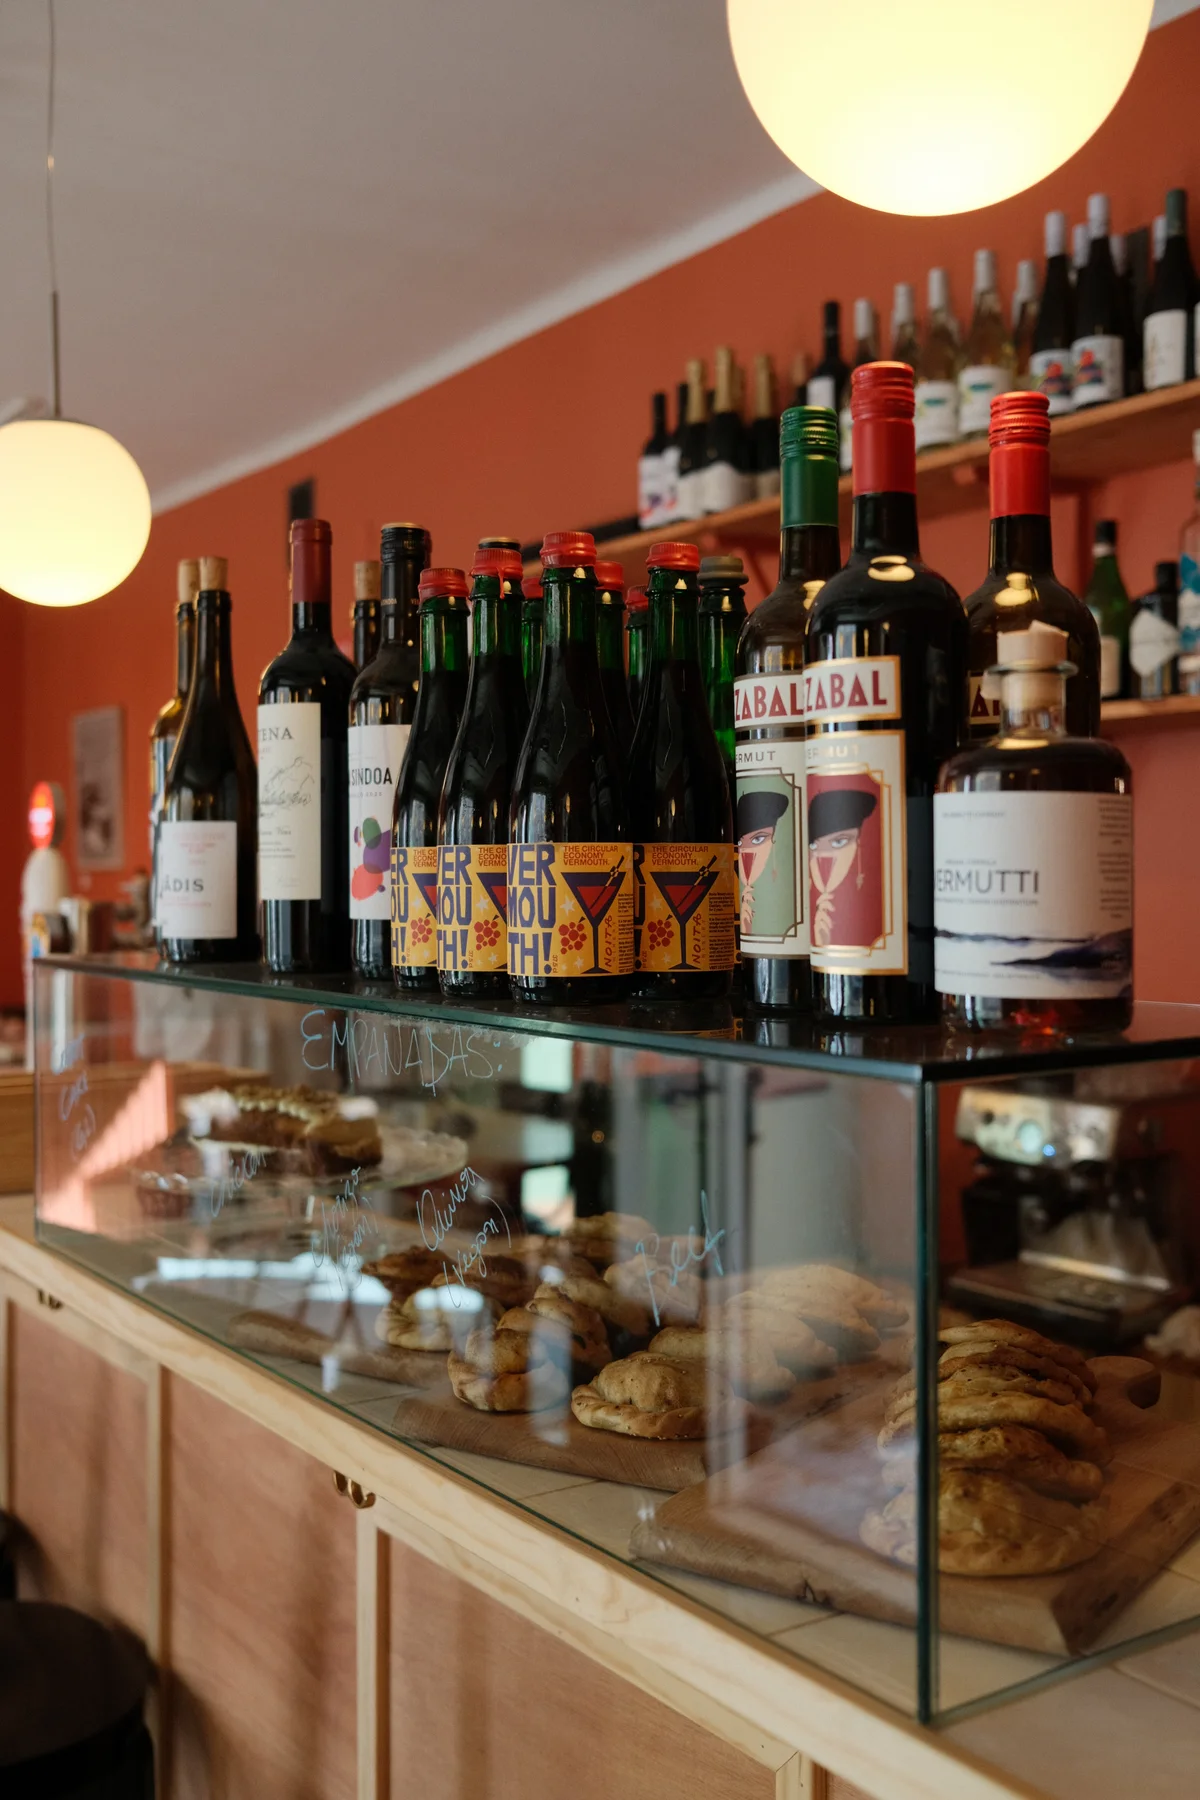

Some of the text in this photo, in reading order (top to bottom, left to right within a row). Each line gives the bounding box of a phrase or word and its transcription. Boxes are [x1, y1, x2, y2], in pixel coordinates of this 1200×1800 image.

[734, 683, 804, 721] ZABAL
[806, 671, 888, 711] ZABAL
[351, 767, 393, 786] SINDOA
[508, 845, 557, 886] VER
[652, 845, 709, 853] THE CIRCULAR
[508, 887, 557, 929] MOU
[508, 932, 553, 975] TH!
